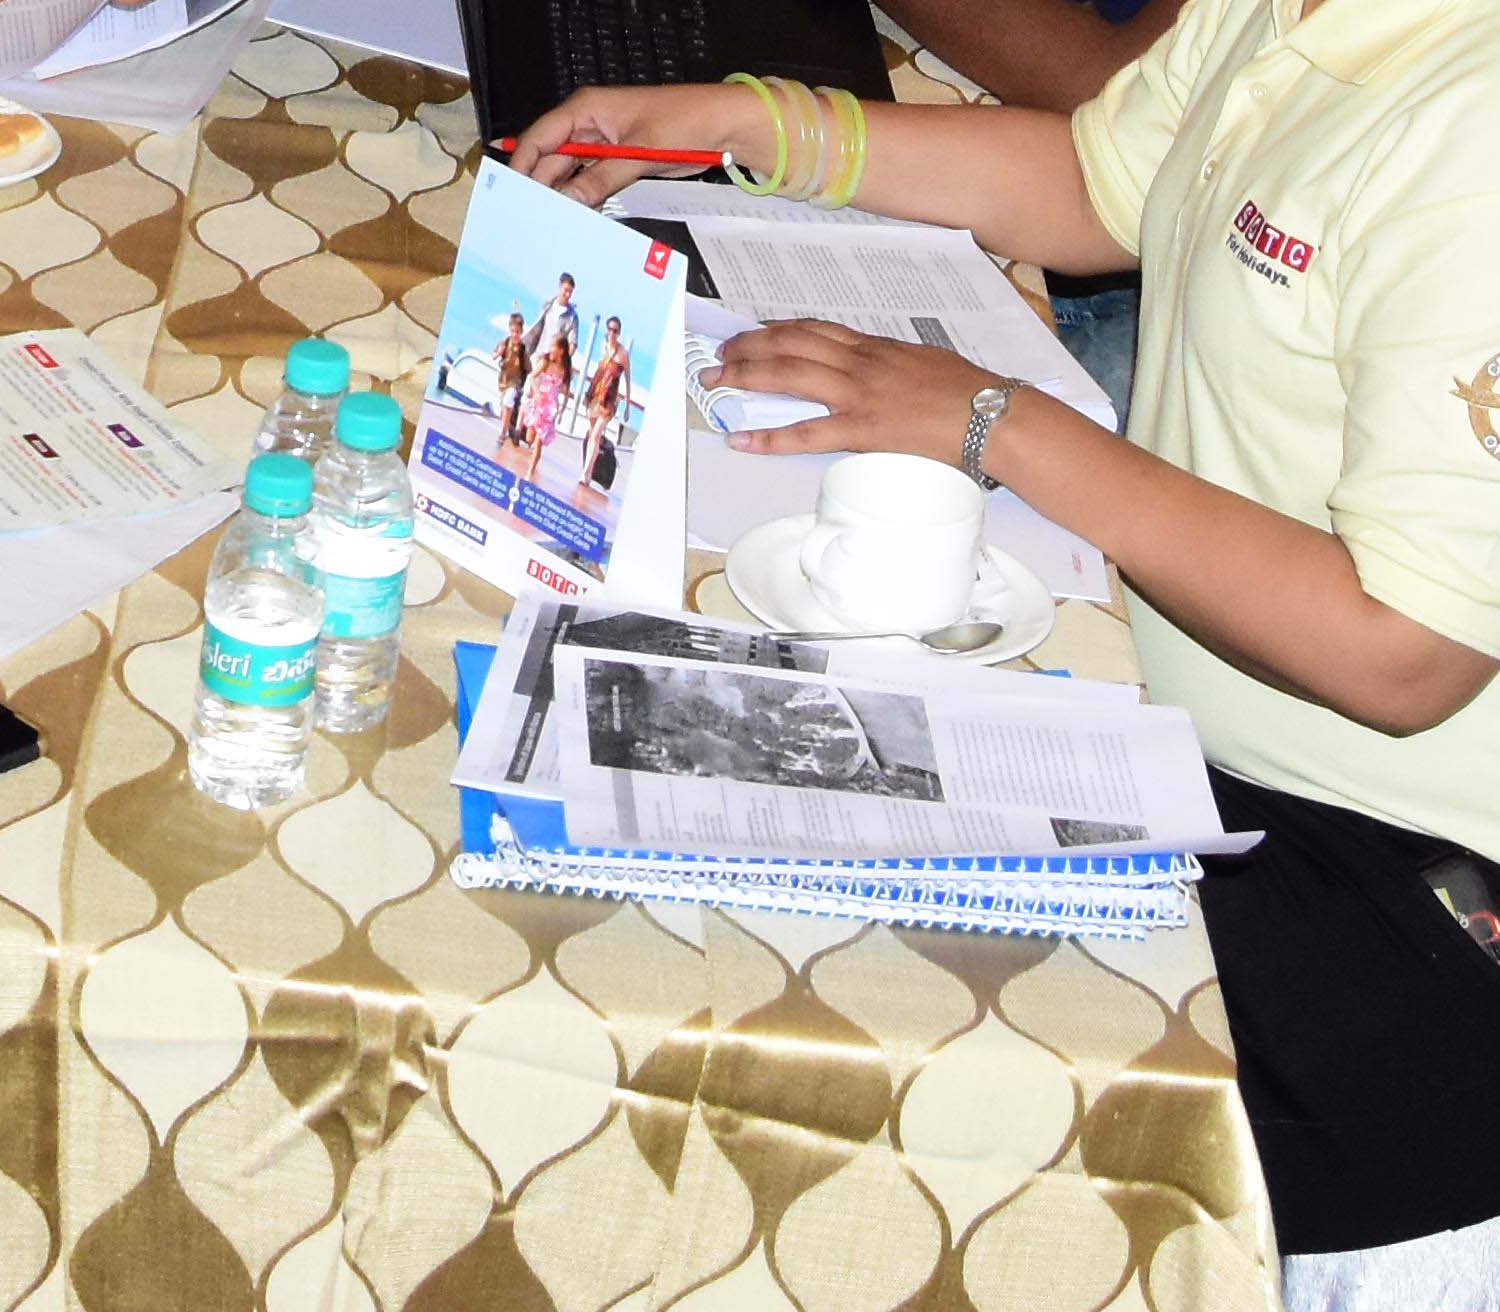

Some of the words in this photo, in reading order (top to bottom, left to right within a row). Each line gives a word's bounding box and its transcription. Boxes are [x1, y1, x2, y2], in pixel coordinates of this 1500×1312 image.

[1236, 202, 1308, 268] SOTC
[1226, 232, 1240, 254] For
[1237, 246, 1291, 289] Holidays.
[429, 504, 457, 529] HDFC
[457, 519, 486, 545] BANK
[528, 560, 579, 596] SOTC
